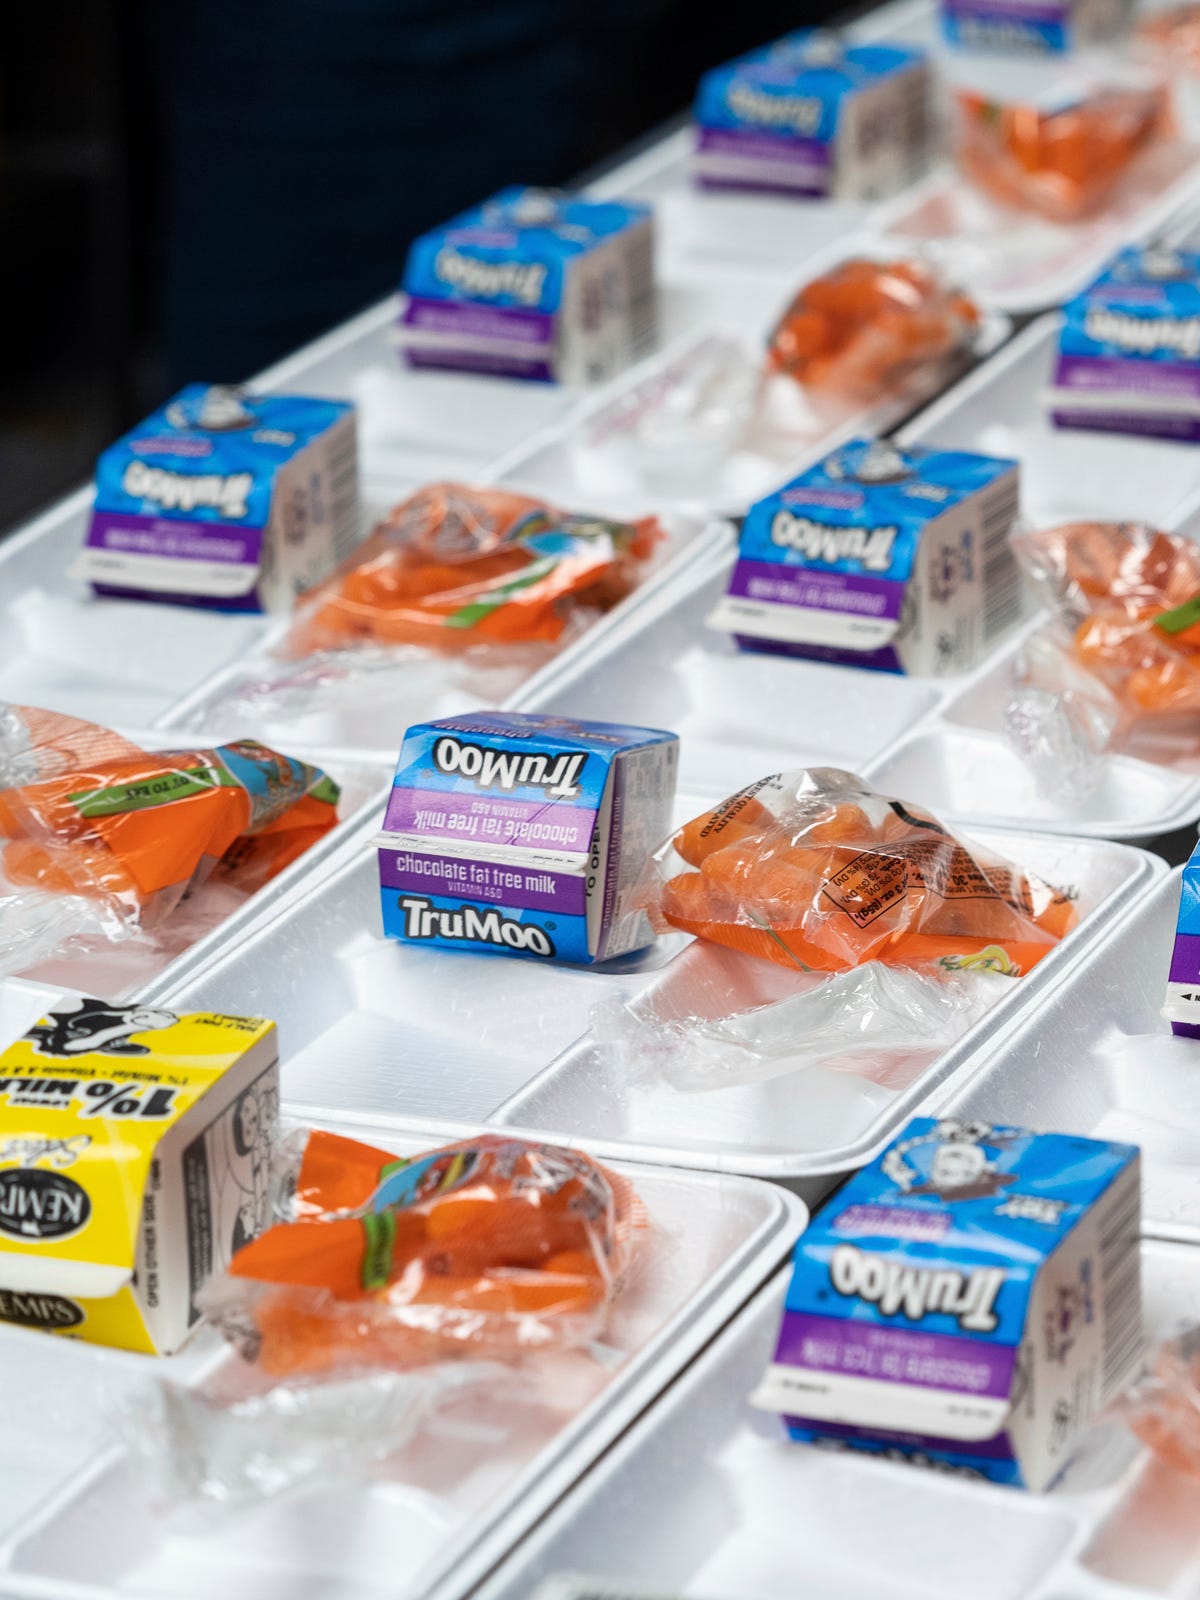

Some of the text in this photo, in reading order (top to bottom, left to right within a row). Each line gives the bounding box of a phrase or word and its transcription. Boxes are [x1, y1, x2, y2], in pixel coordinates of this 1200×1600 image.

[437, 738, 586, 796] TruMoo
[413, 810, 447, 831] milk
[448, 813, 480, 836] free
[504, 820, 579, 844] chocolate
[714, 799, 747, 834] QUALITY
[397, 853, 467, 880] chocolate
[470, 864, 491, 884] fat
[525, 874, 556, 895] milk
[402, 899, 552, 956] TruMoo
[86, 1081, 177, 1117] 1%
[147, 1277, 160, 1308] OPEN
[833, 1245, 1005, 1331] TruMoo
